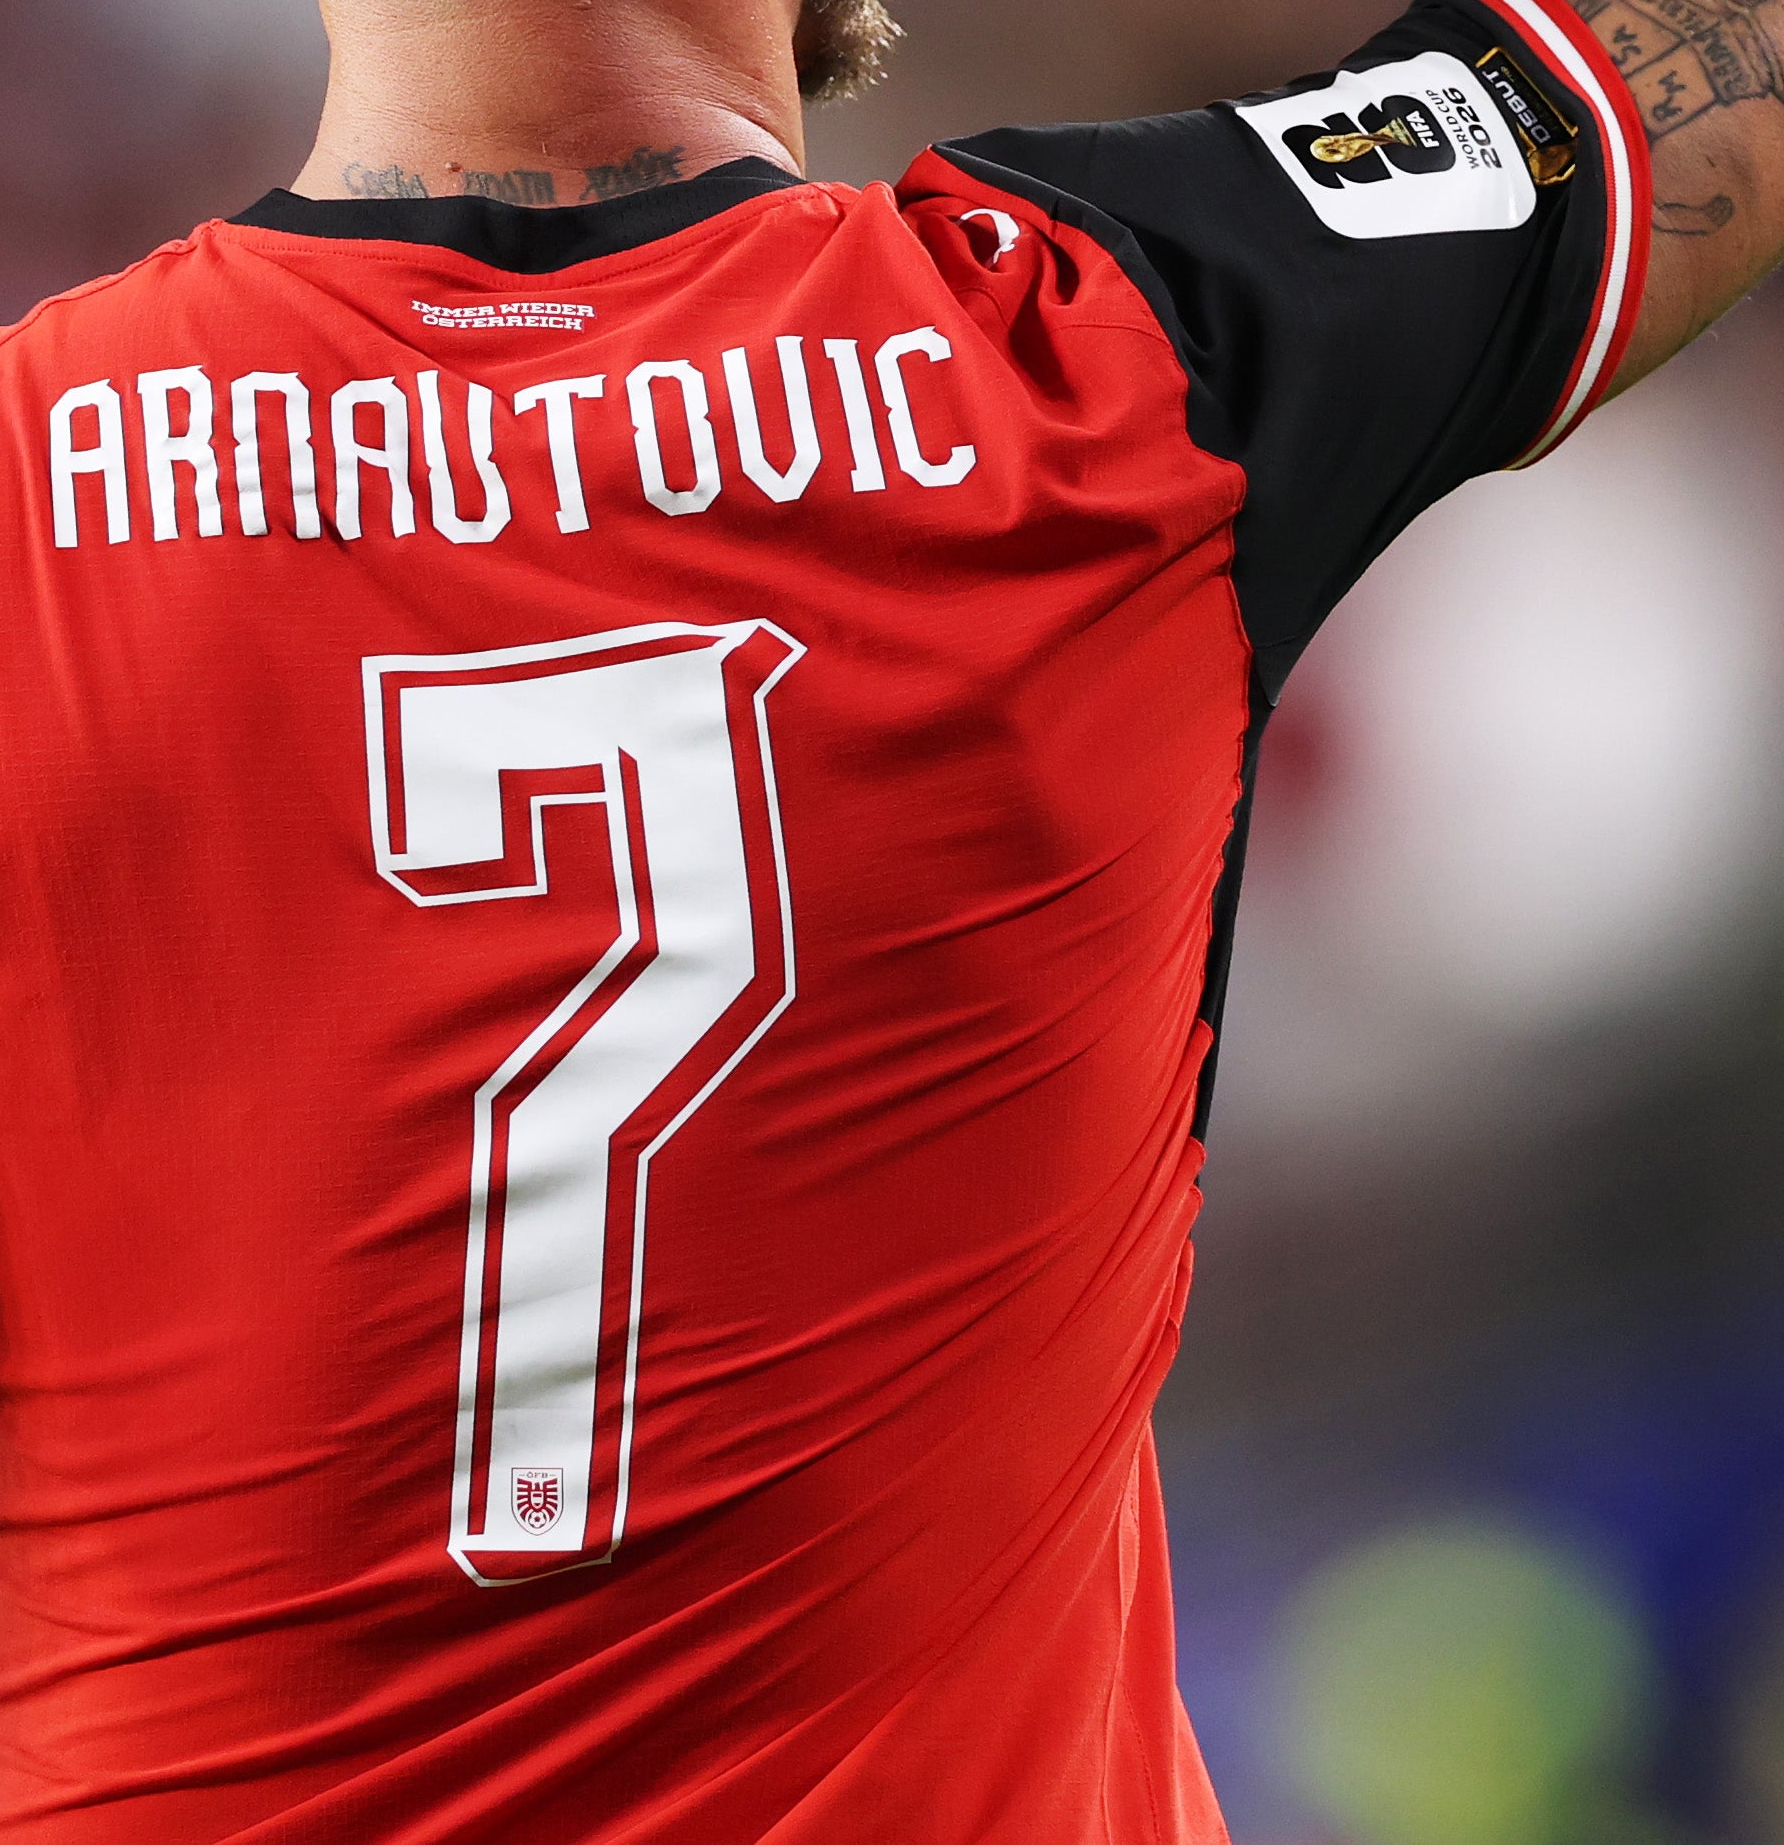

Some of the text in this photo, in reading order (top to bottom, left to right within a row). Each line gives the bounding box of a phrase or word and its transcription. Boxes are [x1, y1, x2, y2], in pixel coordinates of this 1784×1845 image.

[1405, 110, 1440, 149] FIFA
[1426, 88, 1480, 170] WORLD CUP
[1443, 87, 1502, 170] 2026
[1483, 69, 1552, 145] DEBUT
[411, 300, 595, 318] IMMER WIEDER
[48, 326, 976, 549] ARNAUTOVIC
[362, 617, 808, 1587] 7
